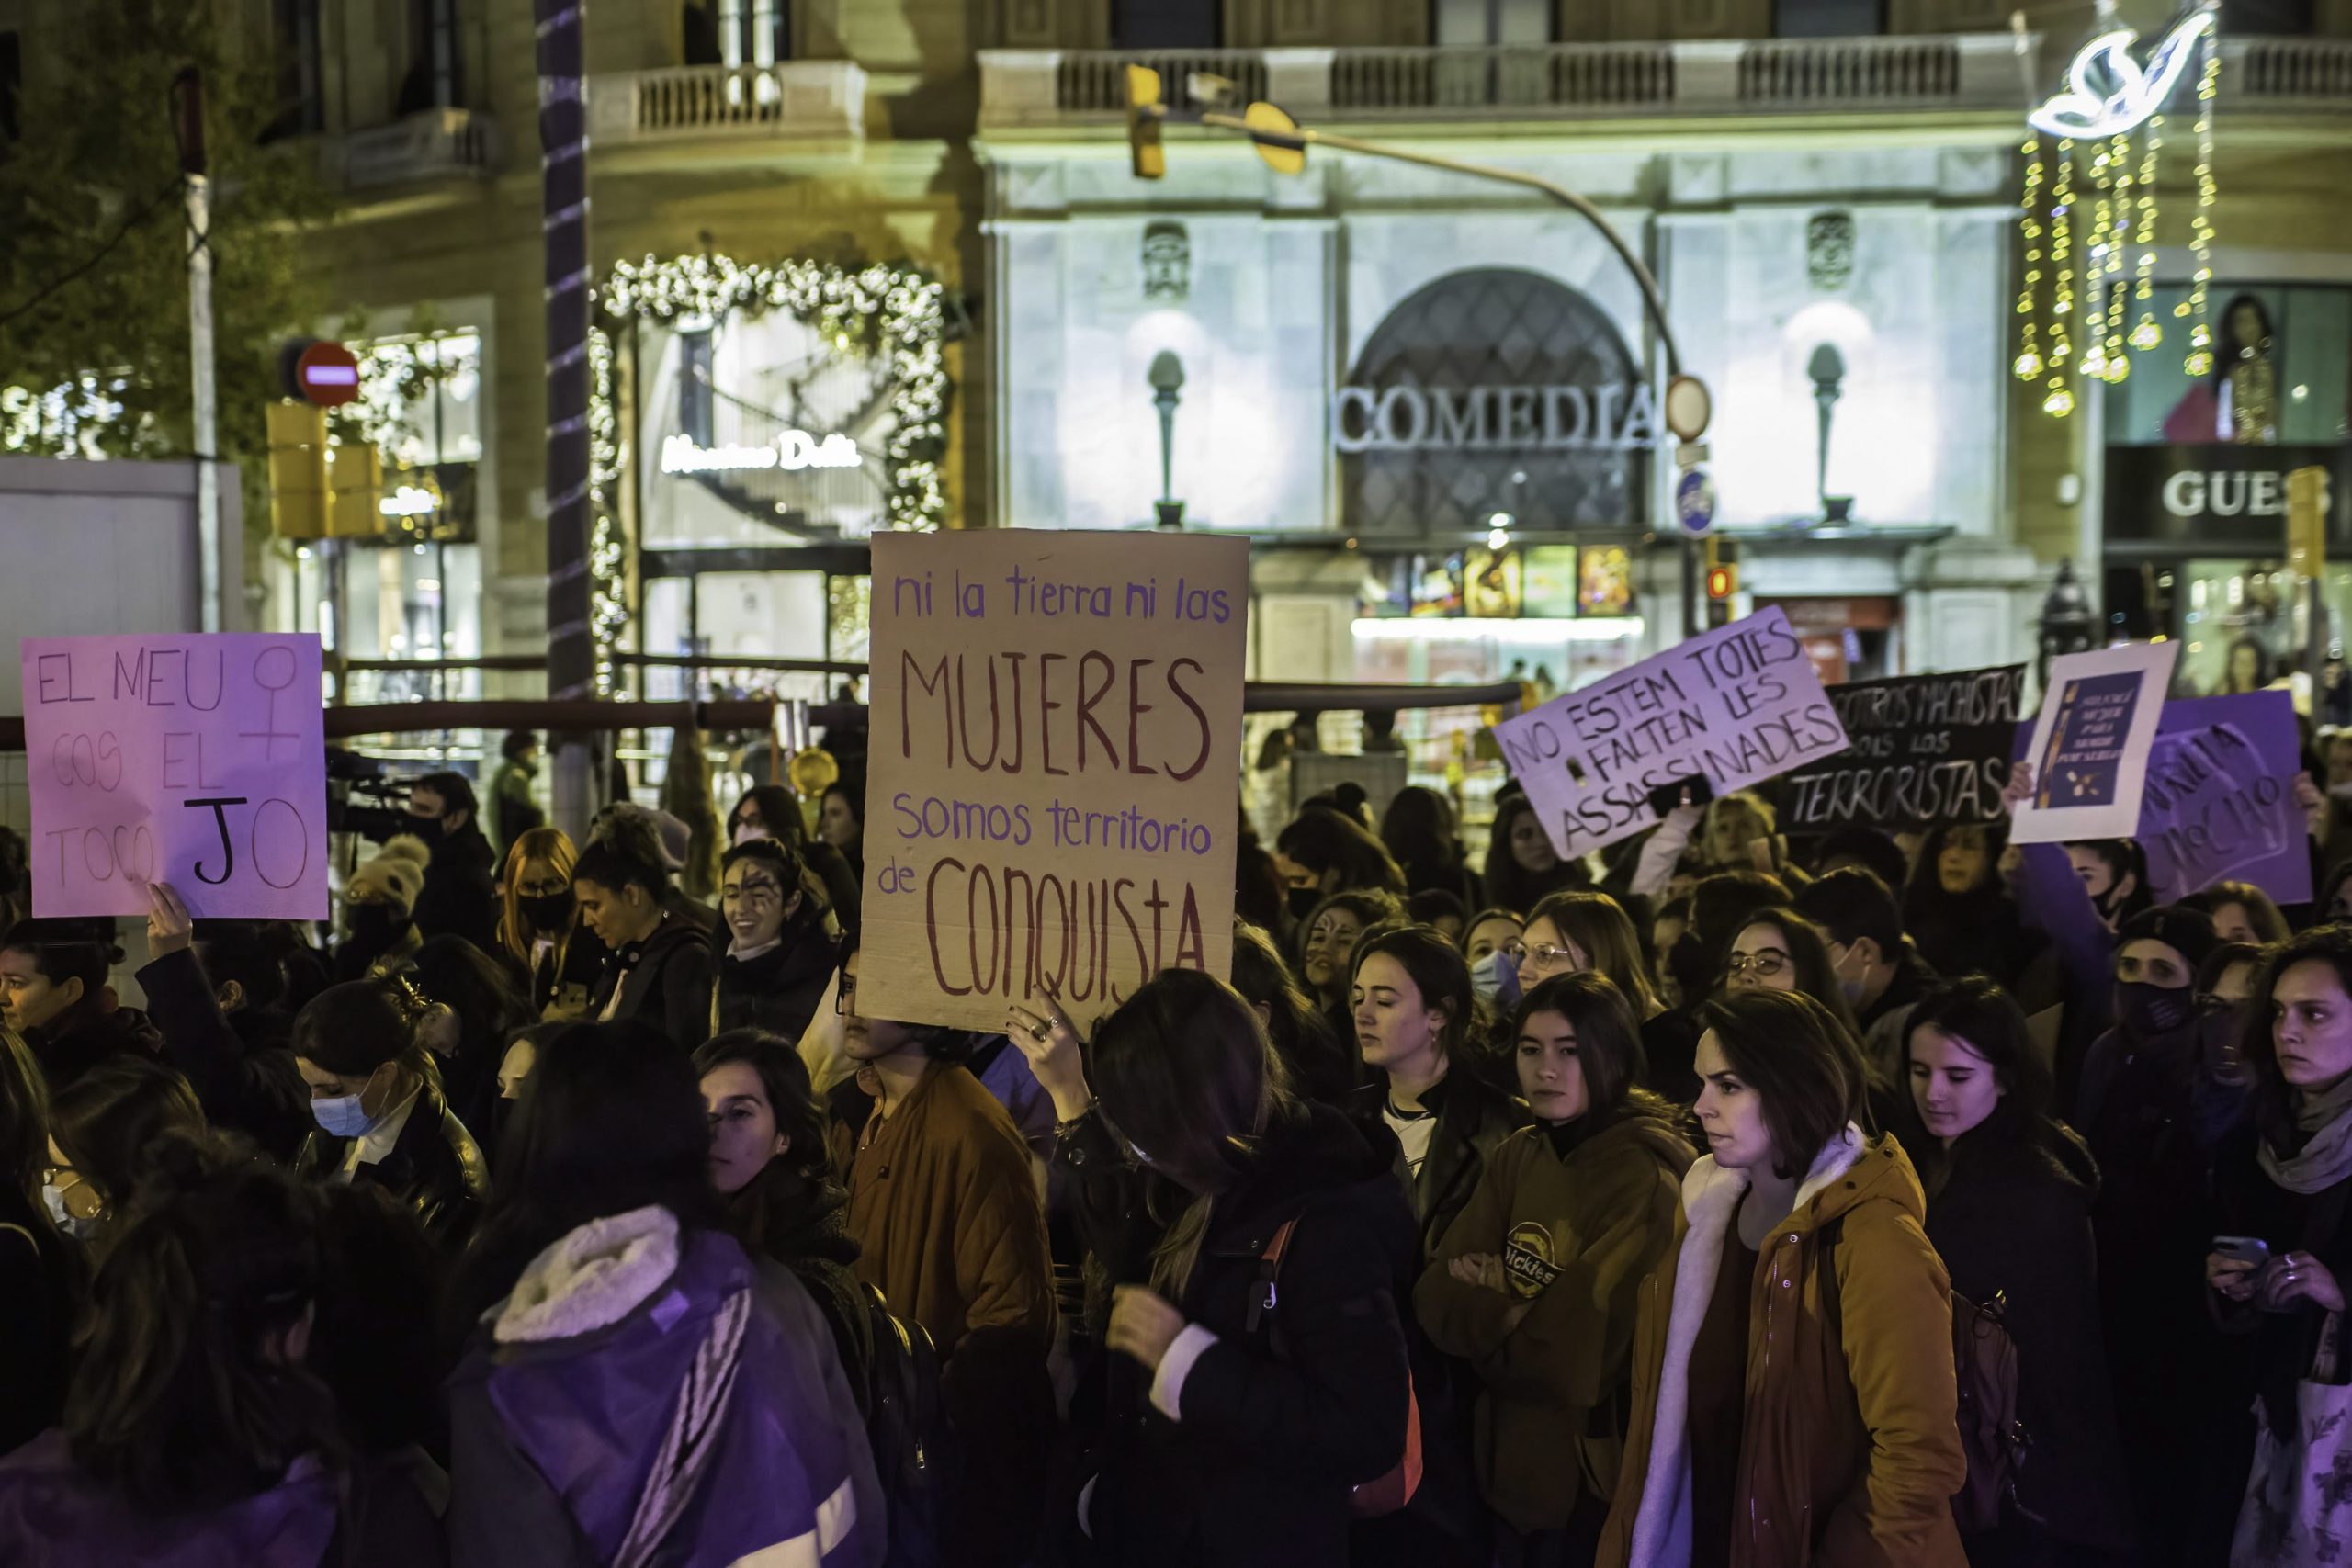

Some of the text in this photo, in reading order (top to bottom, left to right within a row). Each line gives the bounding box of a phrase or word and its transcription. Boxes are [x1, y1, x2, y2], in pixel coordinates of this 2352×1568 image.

[1334, 382, 1657, 453] COMEDIA
[894, 563, 1231, 624] ni la tierra ni las
[38, 647, 225, 712] EL MEU
[1505, 617, 1802, 773] NO ESTEM TOTES
[900, 649, 1212, 783] MUJERES
[1587, 672, 1788, 784] FALTEN LES
[52, 730, 226, 793] COS EL
[1792, 757, 2006, 823] TERRORISTAS
[45, 796, 309, 890] TOCO JO
[1046, 798, 1212, 855] territorio
[877, 855, 917, 895] de
